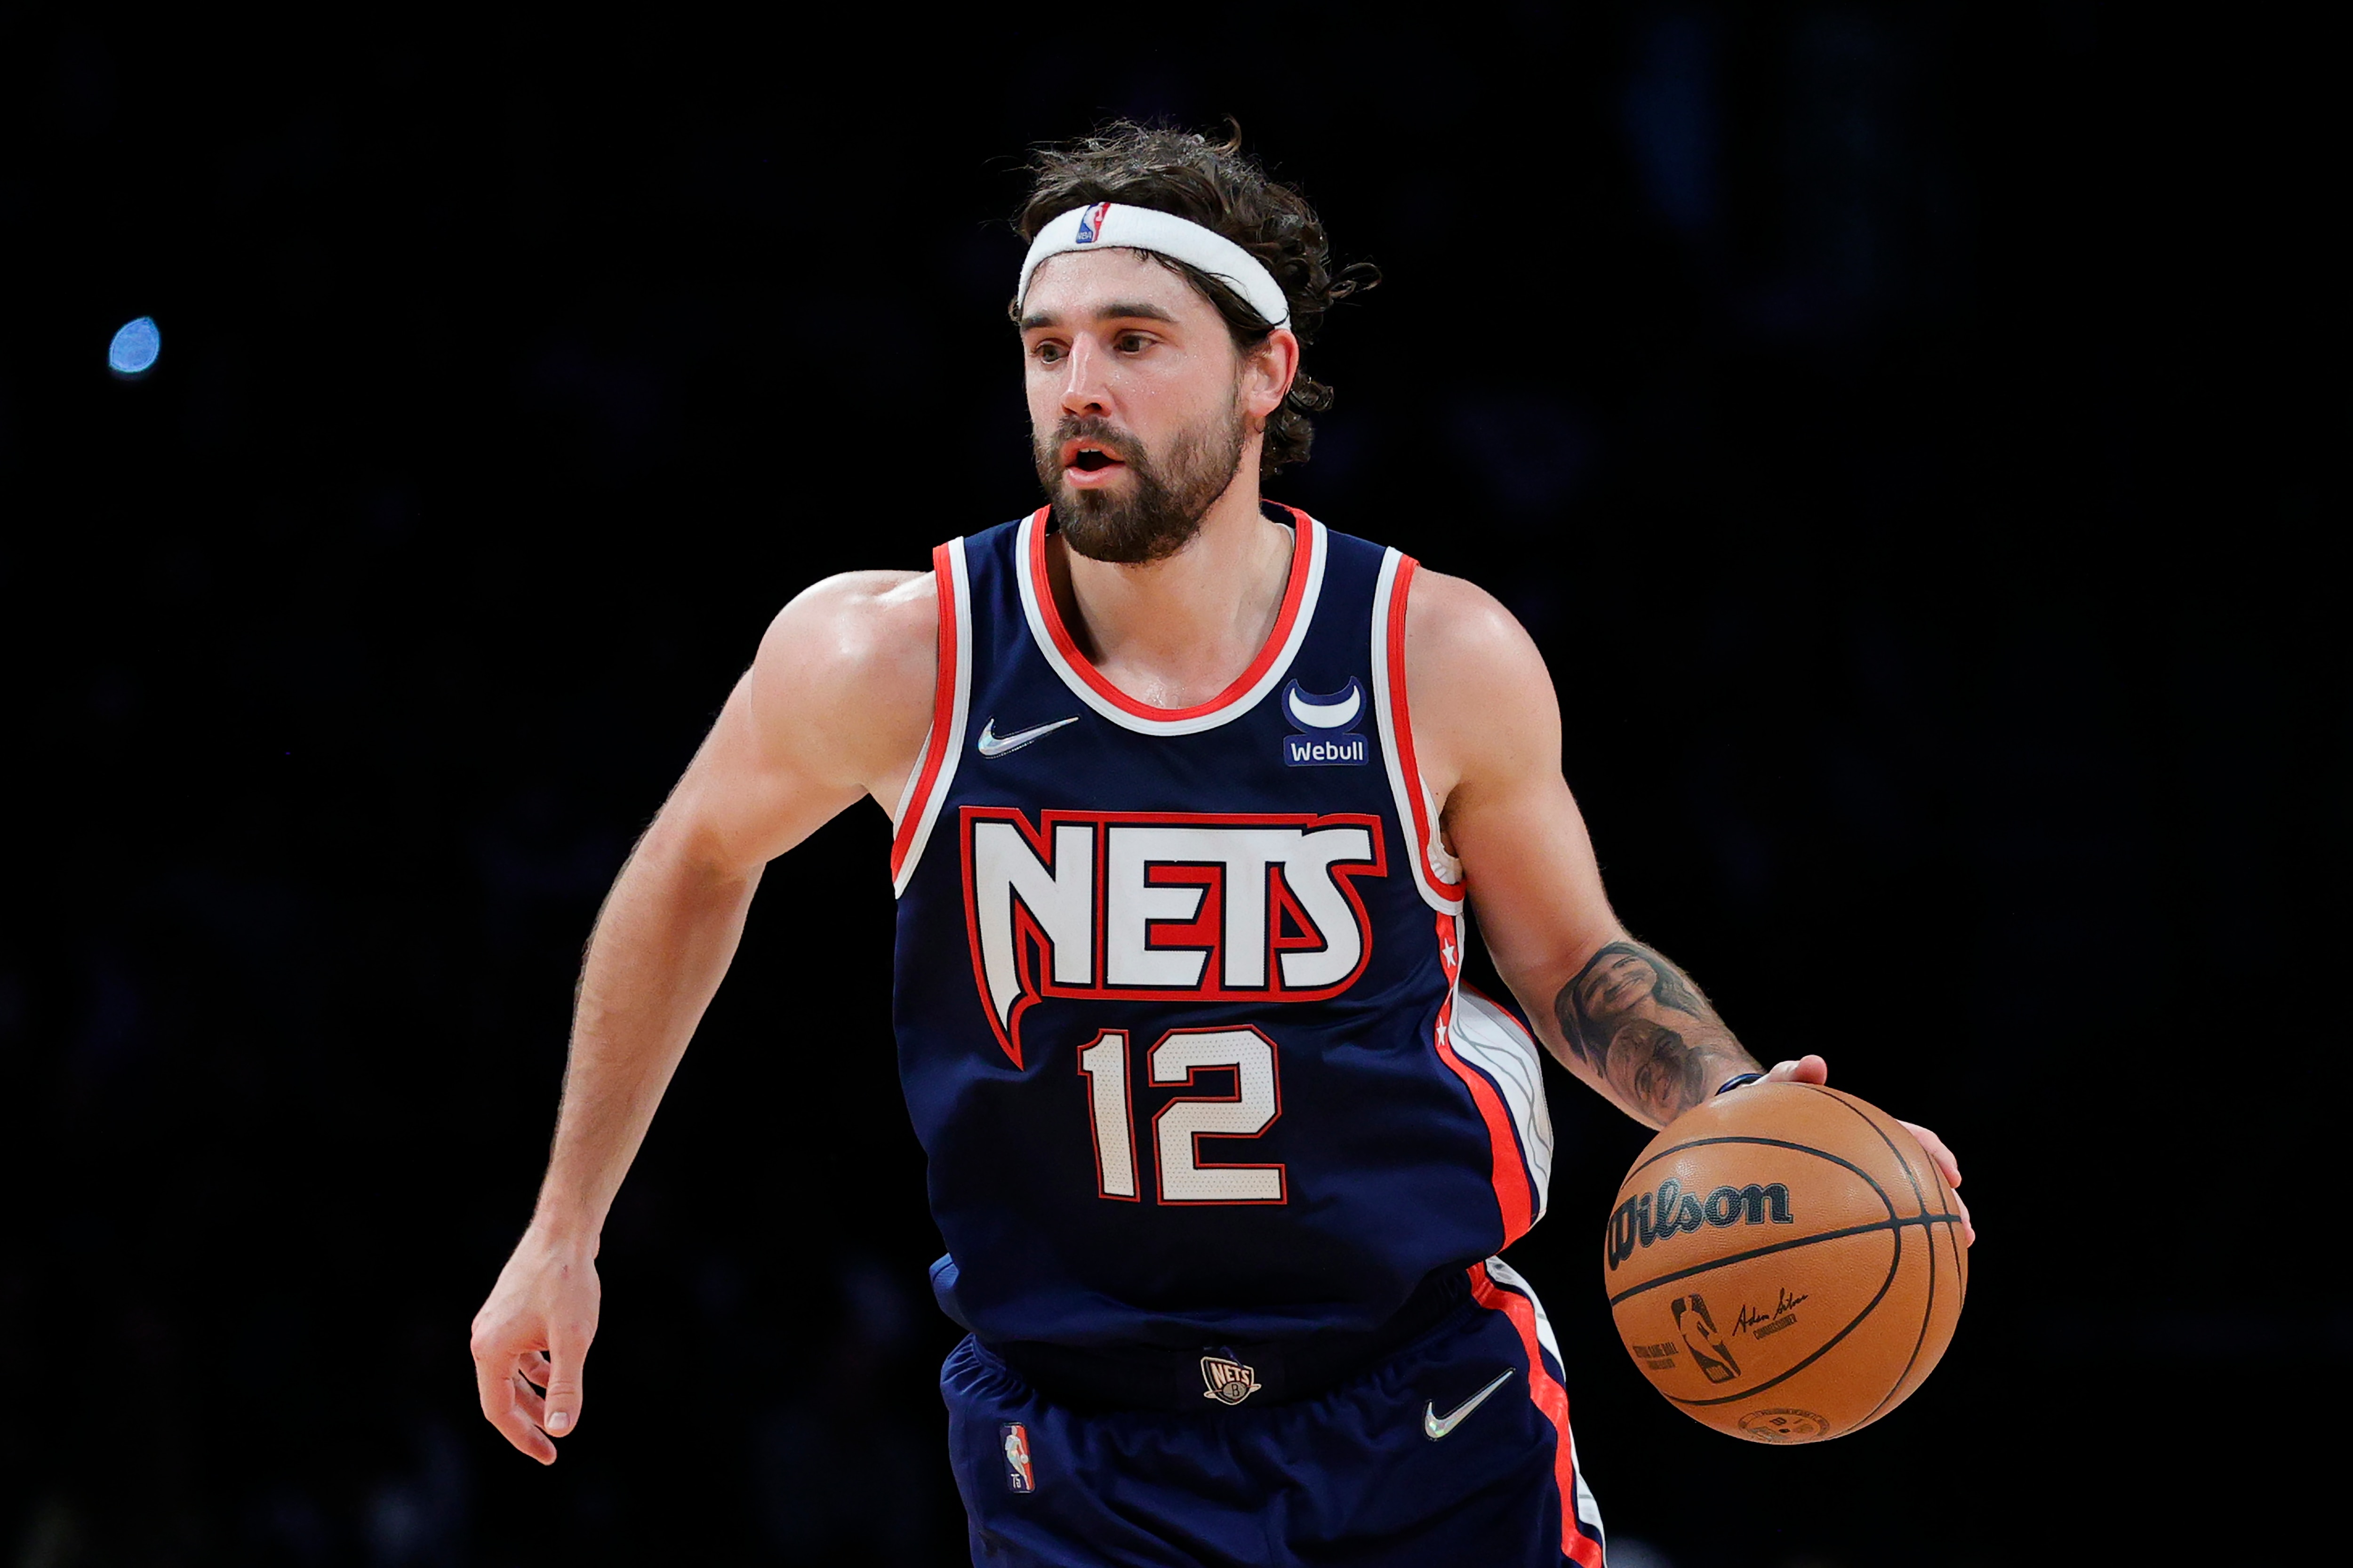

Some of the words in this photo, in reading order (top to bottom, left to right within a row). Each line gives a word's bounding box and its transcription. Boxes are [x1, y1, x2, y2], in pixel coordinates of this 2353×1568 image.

[1290, 741, 1363, 761] Webull
[960, 806, 1387, 1071] NETS
[1078, 1024, 1287, 1205] 12
[1608, 1177, 1793, 1271] Wilson
[1210, 1362, 1249, 1389] NETS
[1232, 1384, 1240, 1397] B
[1010, 1473, 1021, 1488] 75
